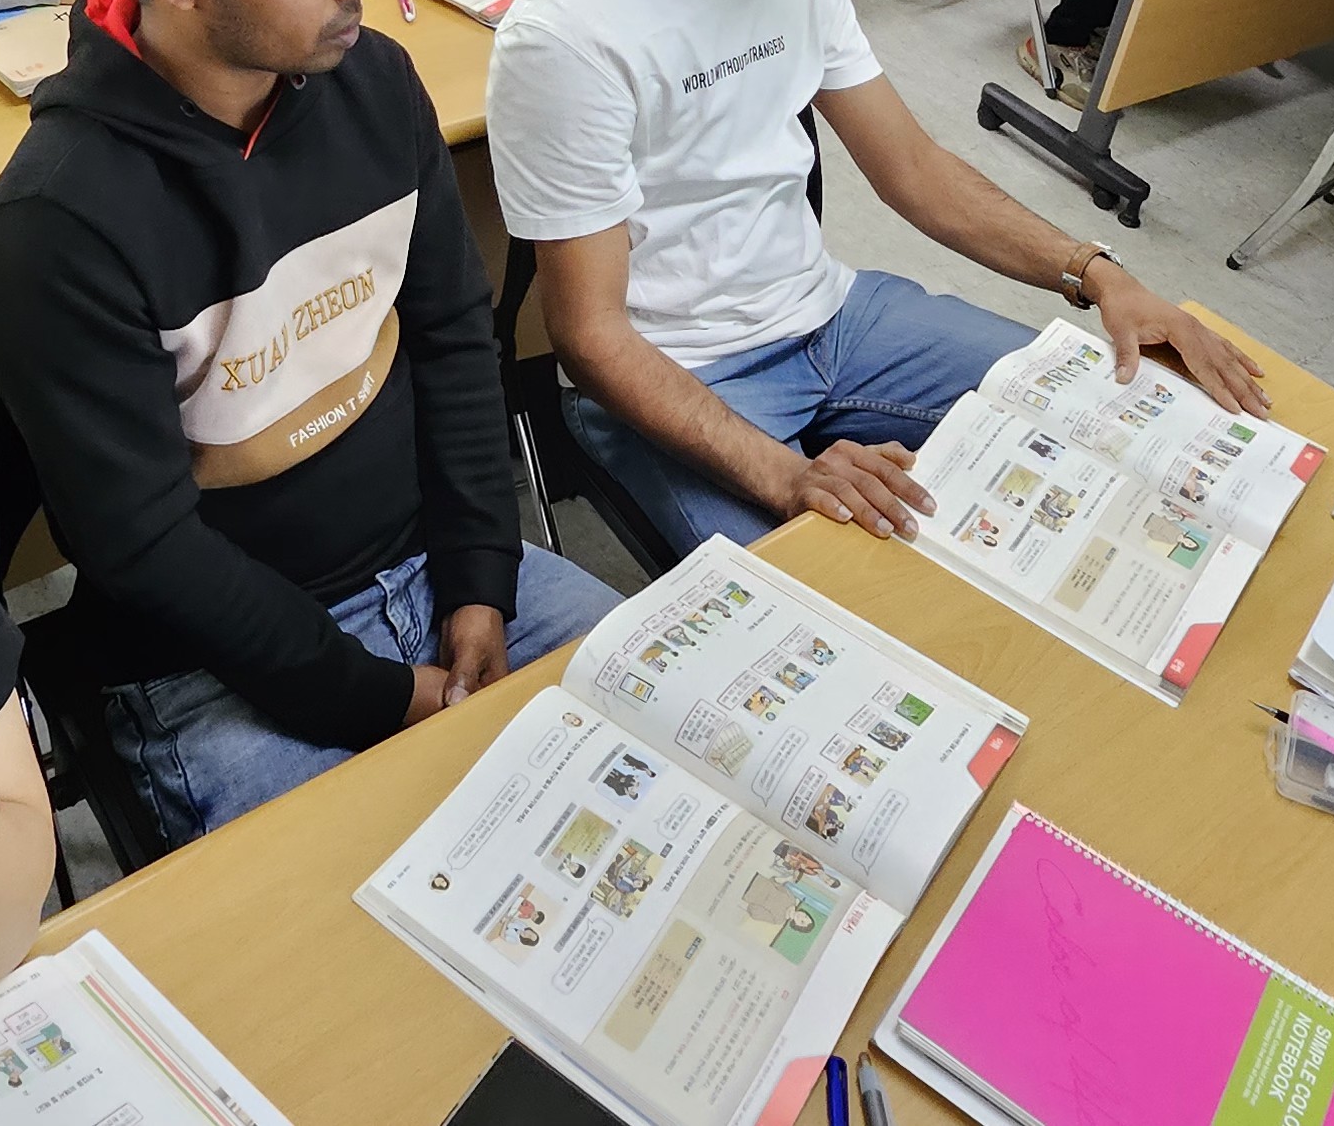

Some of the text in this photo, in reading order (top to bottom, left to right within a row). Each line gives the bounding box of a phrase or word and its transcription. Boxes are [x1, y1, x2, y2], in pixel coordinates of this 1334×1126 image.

[292, 268, 376, 341] ZHEON
[289, 404, 347, 448] FASHION
[346, 397, 357, 411] T
[1269, 1012, 1312, 1103] NOTEBOOK
[1299, 1024, 1332, 1086] SIMPLE
